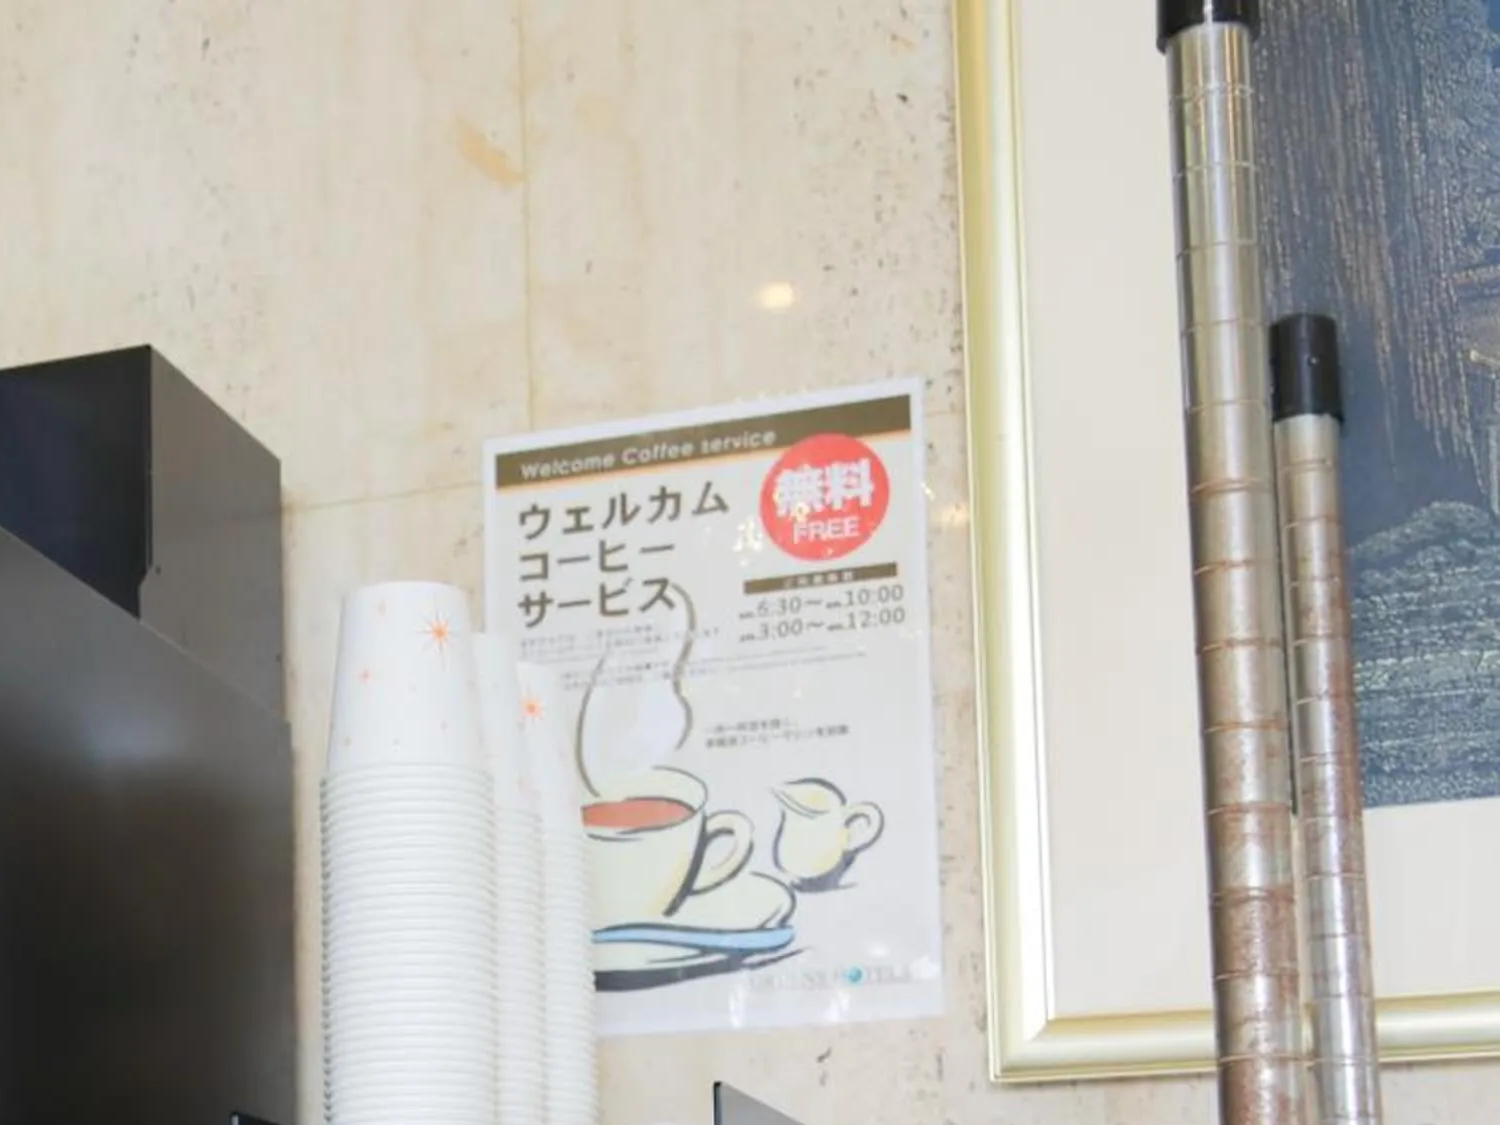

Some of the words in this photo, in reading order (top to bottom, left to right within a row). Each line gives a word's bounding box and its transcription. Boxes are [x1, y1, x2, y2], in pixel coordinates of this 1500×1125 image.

[520, 453, 615, 480] Welcome
[621, 443, 694, 466] Coffee
[517, 480, 730, 541] ウェルカム
[772, 456, 875, 520] 無料
[792, 516, 861, 545] FREE
[519, 539, 676, 582] コーヒー
[516, 576, 677, 629] サービス
